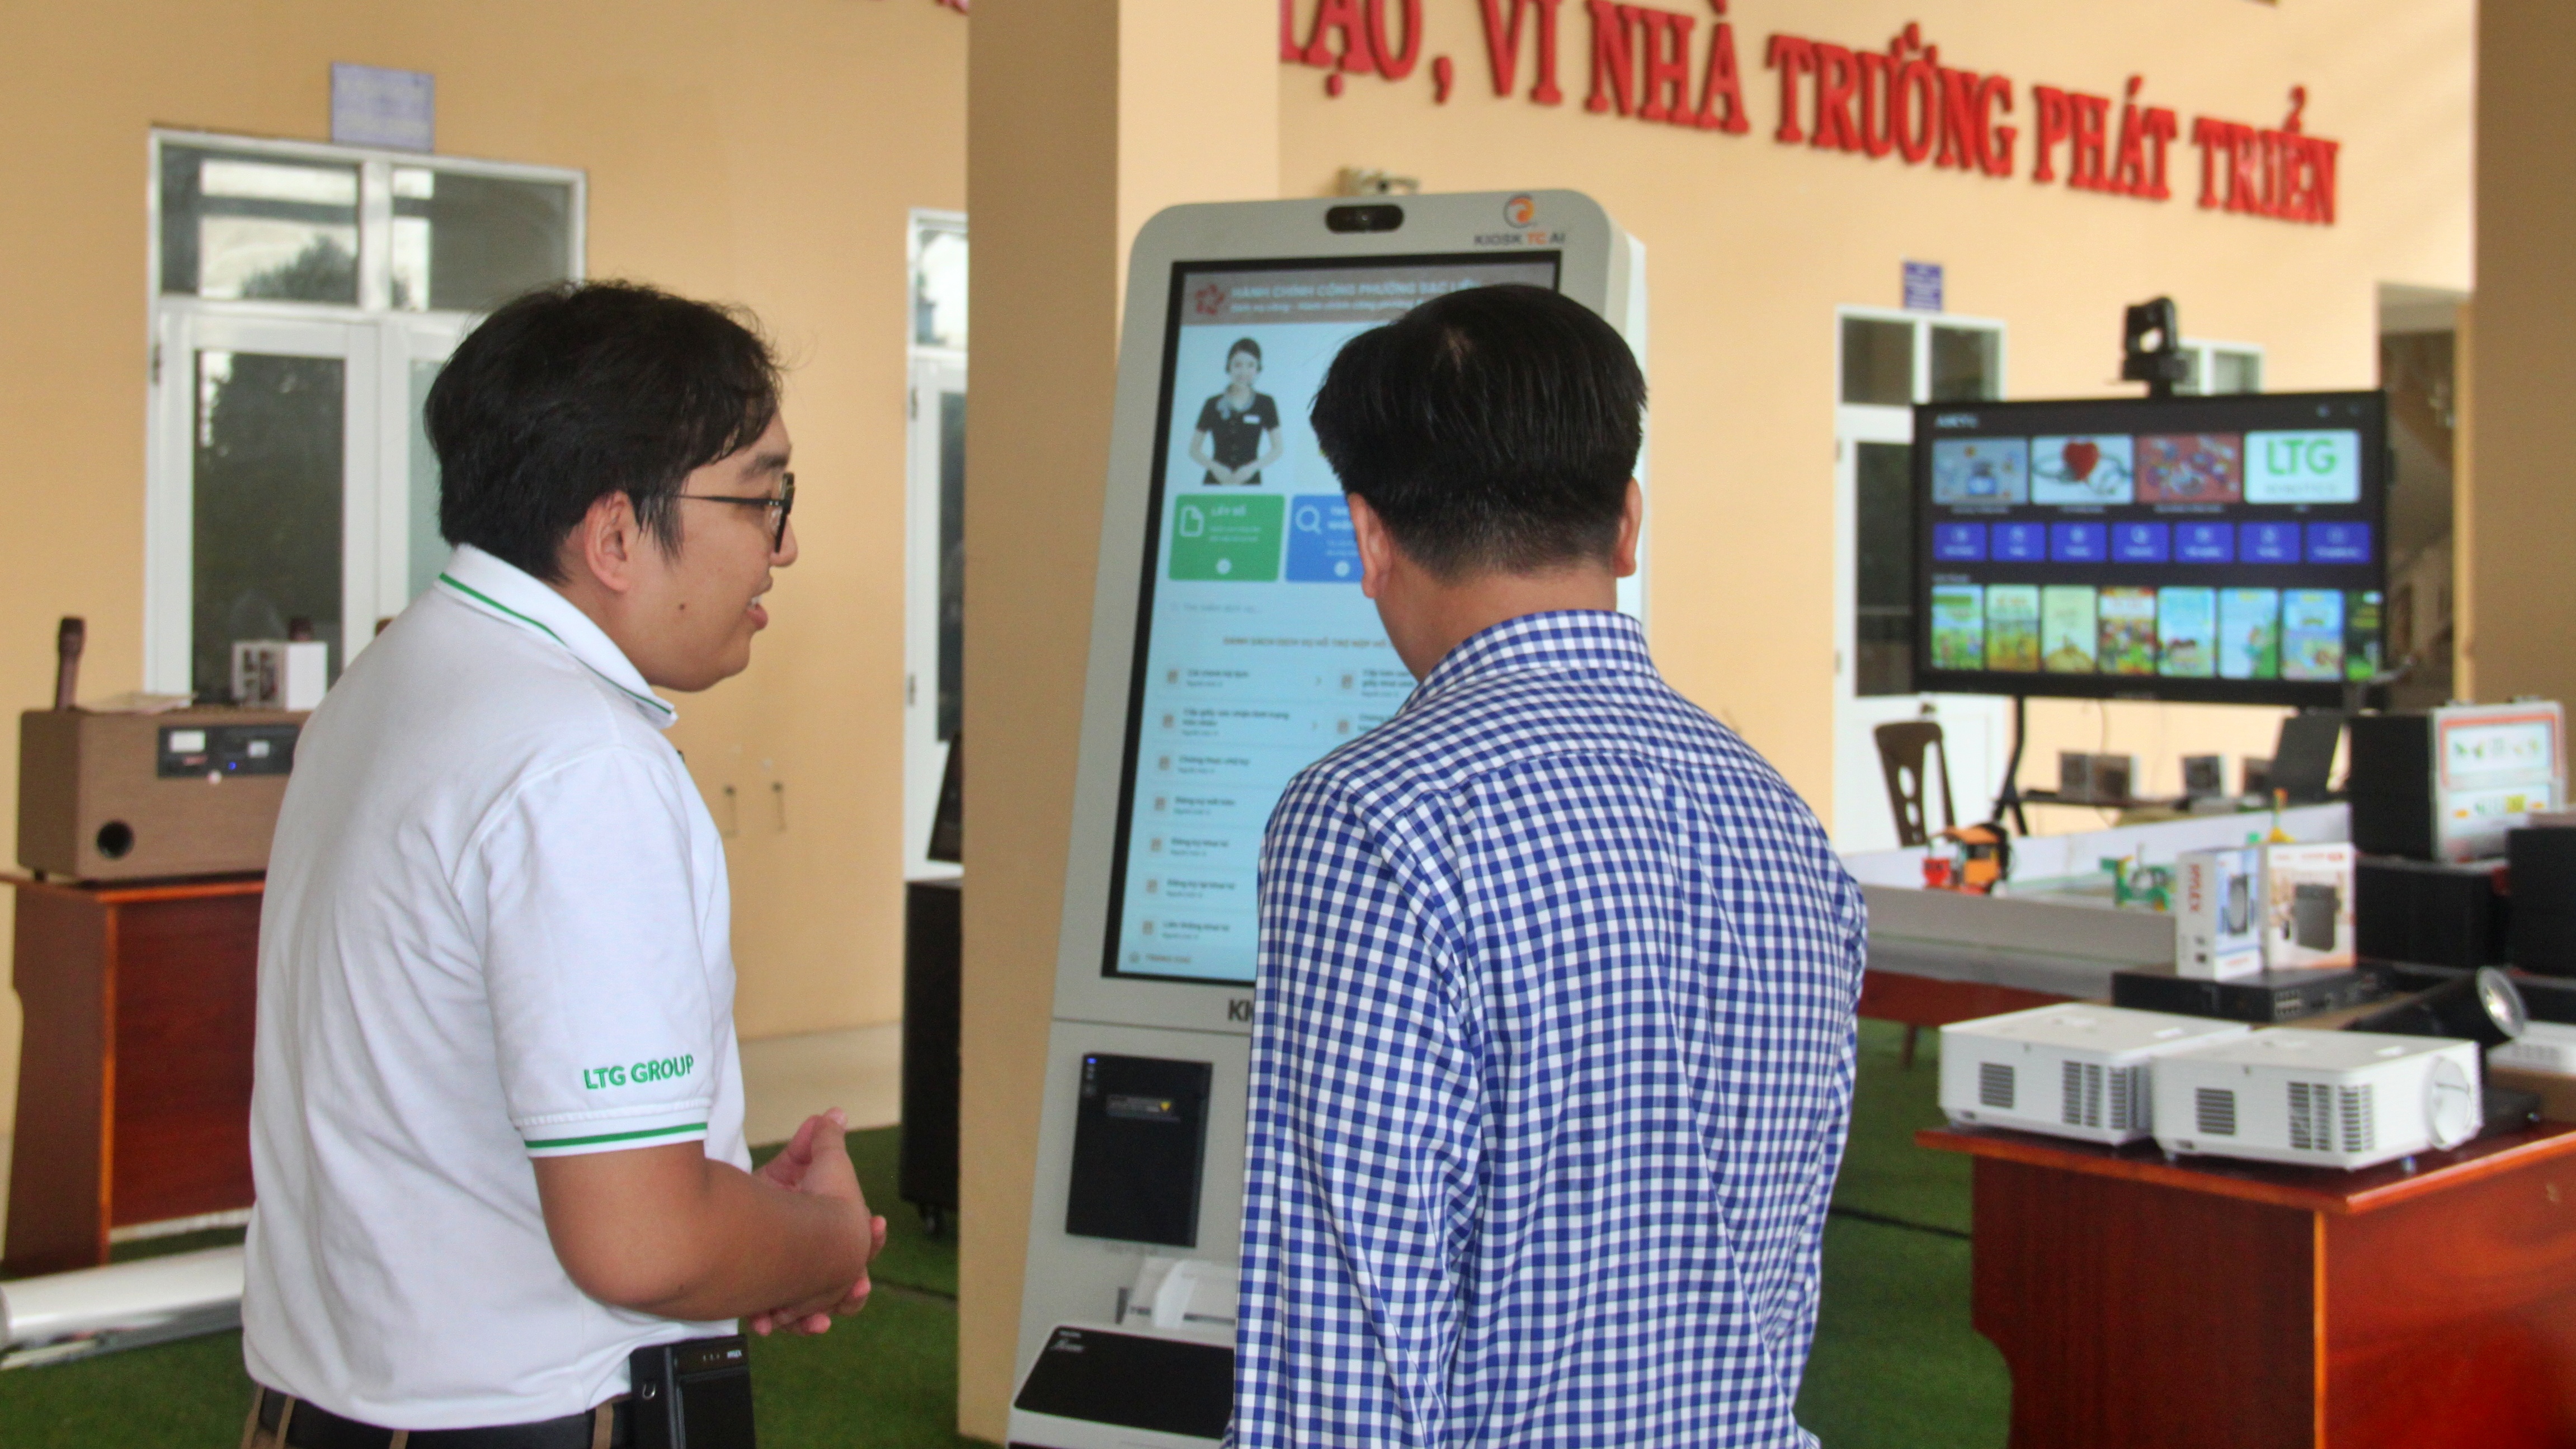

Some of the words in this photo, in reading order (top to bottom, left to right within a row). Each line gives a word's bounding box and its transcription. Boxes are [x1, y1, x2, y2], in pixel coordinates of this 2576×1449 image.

[2031, 75, 2177, 200] PHÁT
[1474, 234, 1522, 246] KIOSK
[1527, 232, 1547, 245] TC
[1550, 232, 1566, 244] AI
[2266, 437, 2338, 476] LTG
[583, 1065, 626, 1089] LTG
[631, 1054, 694, 1083] GROUP
